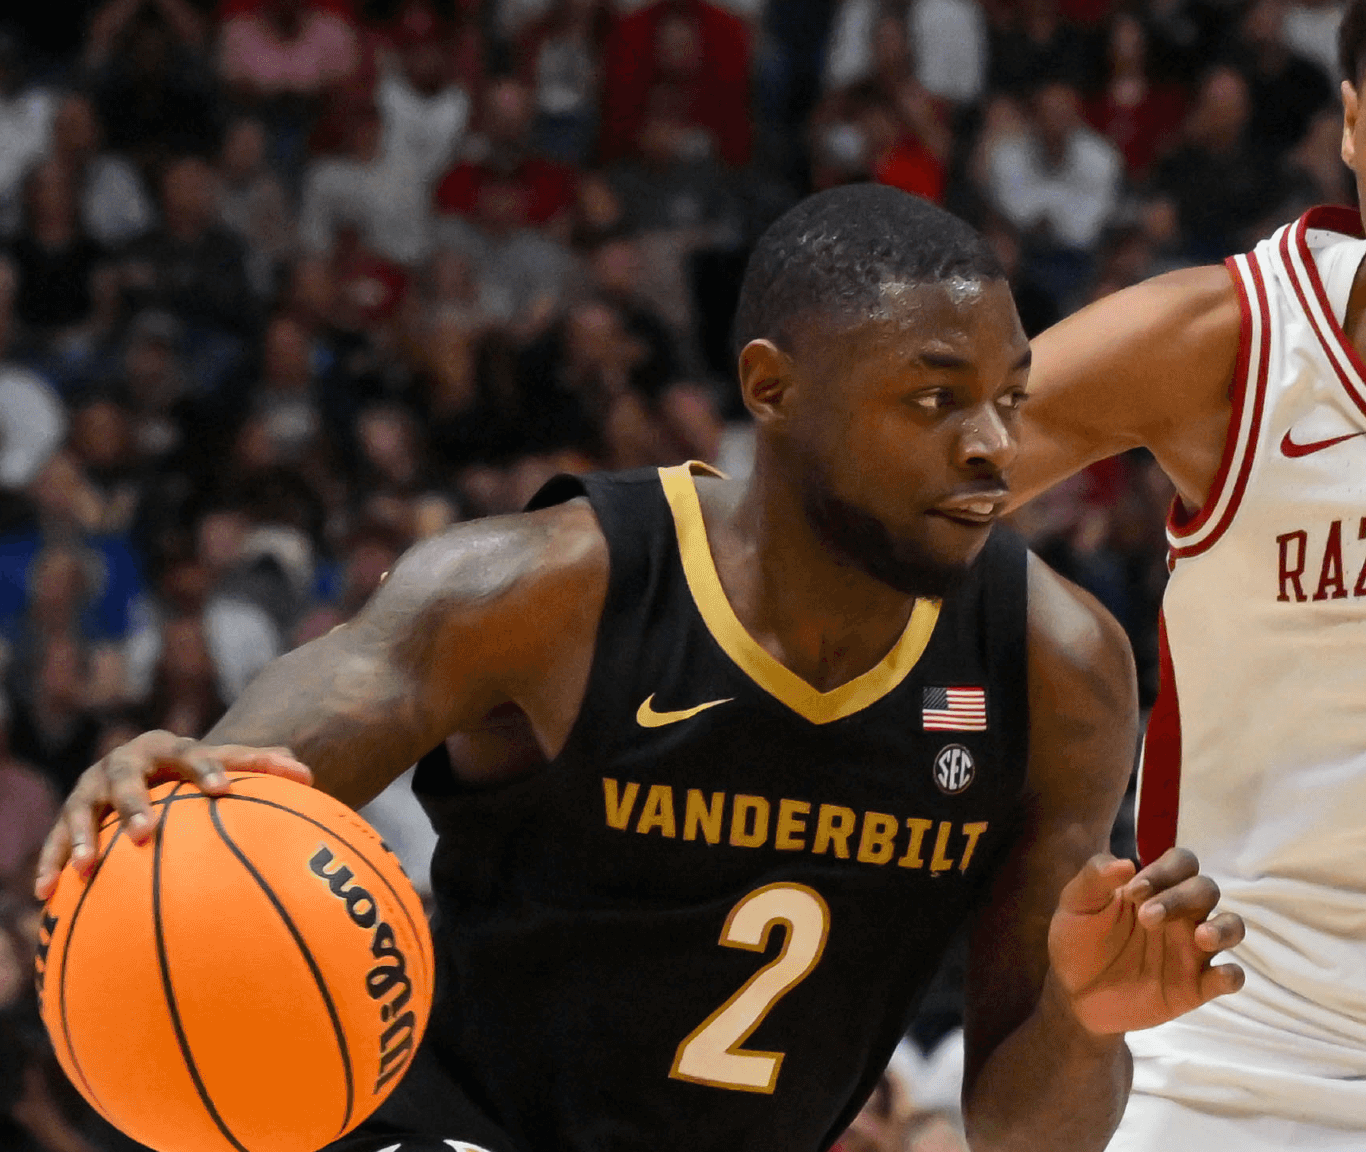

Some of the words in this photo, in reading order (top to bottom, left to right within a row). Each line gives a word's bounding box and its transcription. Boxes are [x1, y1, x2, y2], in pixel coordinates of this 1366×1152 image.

[602, 777, 988, 873] VANDERBILT
[937, 747, 974, 791] SEC
[308, 846, 416, 1095] Wilson
[668, 881, 831, 1094] 2
